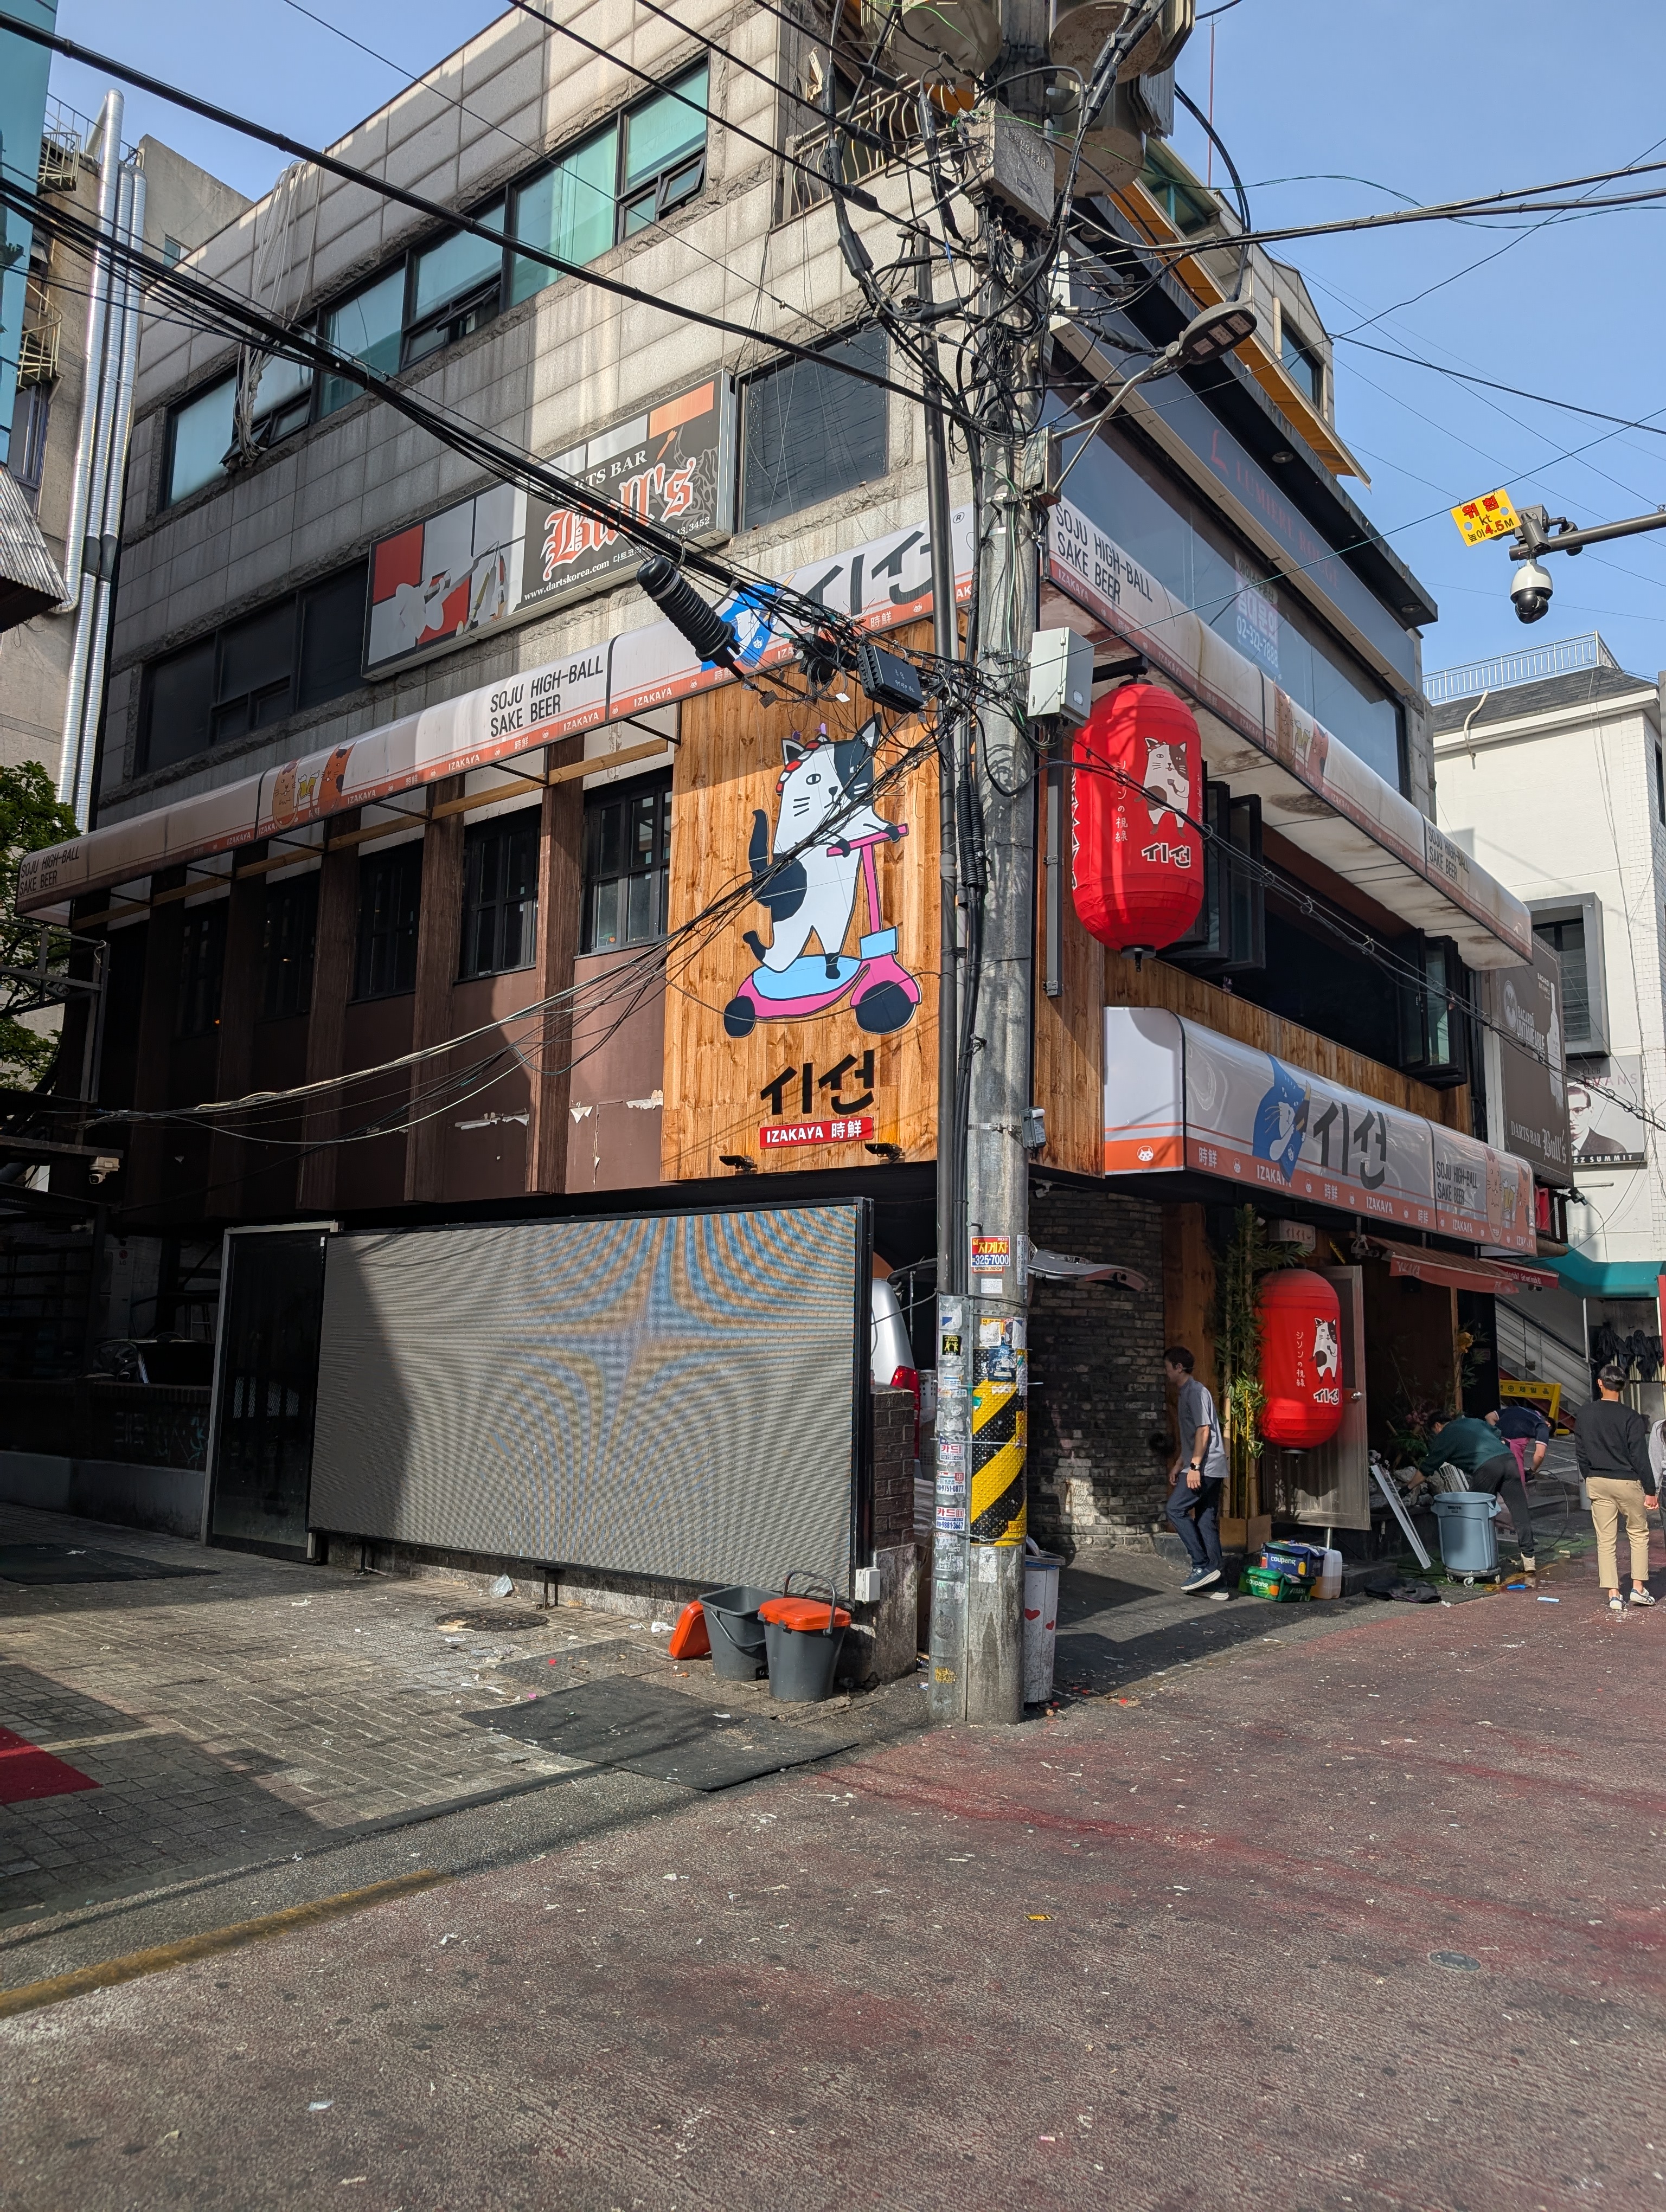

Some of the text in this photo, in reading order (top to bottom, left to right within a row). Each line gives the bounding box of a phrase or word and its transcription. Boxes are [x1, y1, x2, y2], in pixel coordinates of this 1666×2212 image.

[610, 449, 648, 478] BAR
[1479, 515, 1492, 526] kt
[1056, 504, 1154, 603] SOJU HIGH-BALL
[1058, 531, 1121, 605] SAKE BEER
[524, 560, 610, 601] www.dartskorea.com
[1058, 568, 1089, 602] IZAKAYA
[870, 610, 892, 628] 時鮮
[1158, 651, 1183, 677] IZAKAYA
[490, 655, 604, 713] SOJU HIGH-BALL
[633, 686, 673, 708] IZAKAYA
[490, 693, 561, 738] SAKE BEER
[563, 711, 599, 732] IZAKAYA
[1240, 717, 1261, 740] IZAKAYA
[448, 754, 480, 771] IZAKAYA
[347, 789, 376, 805] IZAKAYA
[1331, 792, 1350, 813] IZAKAYA
[227, 831, 251, 846] IZAKAYA
[1428, 826, 1470, 874] SOJU HIGH-BALL
[21, 845, 80, 879] SOJU HIGH-BALL
[1429, 846, 1443, 872] SAKE
[1445, 860, 1458, 882] BEER
[19, 871, 58, 897] SAKE BEER
[1582, 1066, 1601, 1075] CLUB
[766, 1120, 862, 1143] IZAKAYA 時鮮
[1510, 1121, 1529, 1141] DARTS
[1529, 1129, 1542, 1149] BAR
[1198, 1146, 1218, 1168] 時鮮
[1590, 1154, 1633, 1163] SUMMIT
[1437, 1161, 1478, 1189] SOJU HIGH-BALL
[1366, 1195, 1394, 1215] IZAKAYA
[1437, 1182, 1465, 1206] SAKE BEER
[1452, 1218, 1473, 1234] IZAKAYA
[978, 1241, 1009, 1253] 지게차
[941, 1445, 958, 1453] 카드
[937, 1507, 956, 1517] 카드
[1270, 1556, 1296, 1566] coupang
[1246, 1578, 1268, 1590] coupang
